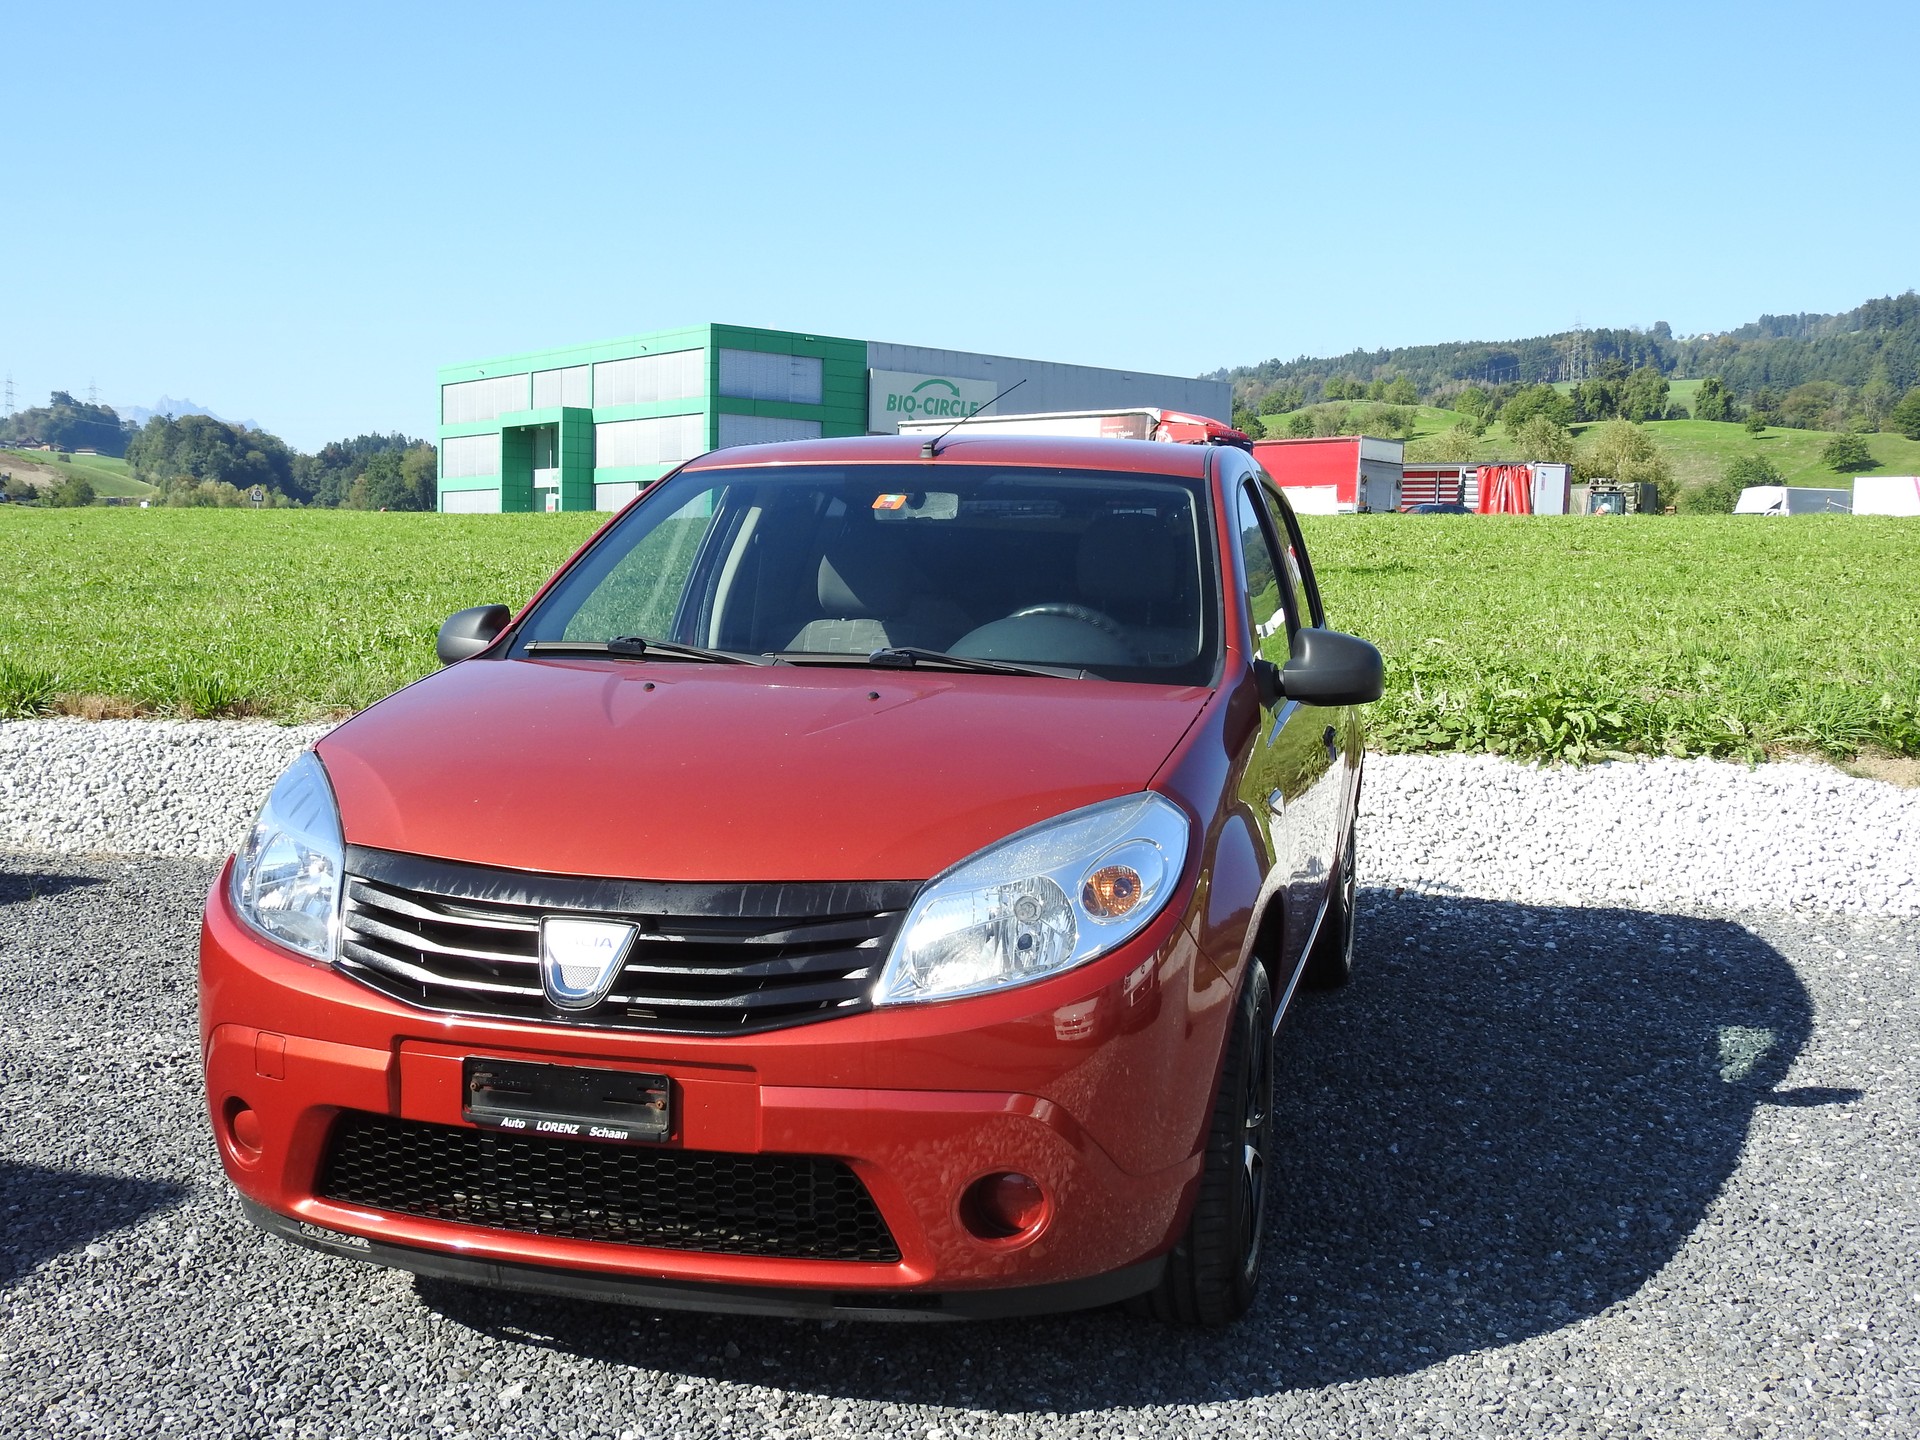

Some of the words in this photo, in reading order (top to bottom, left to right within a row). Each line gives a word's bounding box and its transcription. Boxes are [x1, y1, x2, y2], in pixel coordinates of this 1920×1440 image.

[887, 393, 979, 418] BIO-CIRCLE
[501, 1117, 526, 1129] Auto
[536, 1120, 580, 1135] LORENZ
[589, 1126, 628, 1140] Schaan
